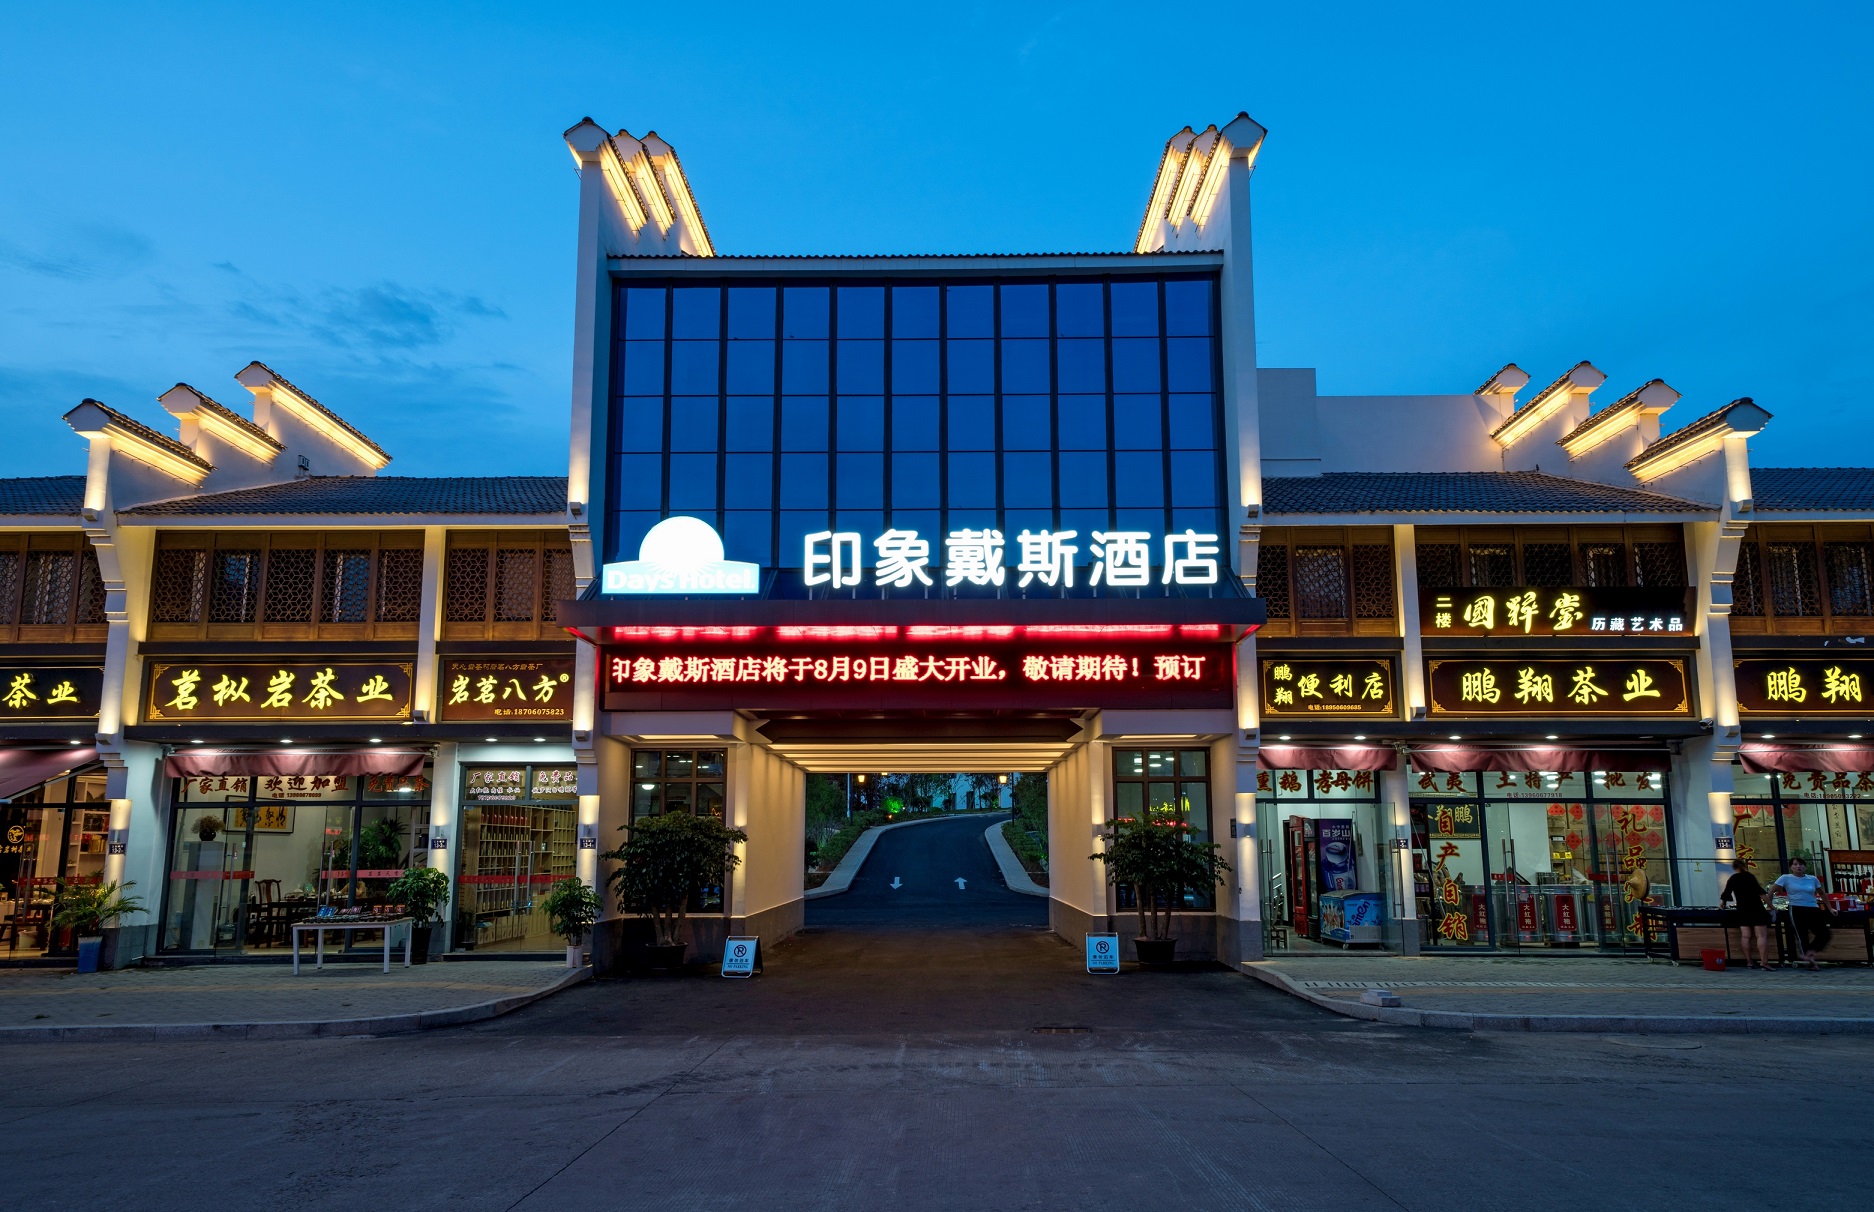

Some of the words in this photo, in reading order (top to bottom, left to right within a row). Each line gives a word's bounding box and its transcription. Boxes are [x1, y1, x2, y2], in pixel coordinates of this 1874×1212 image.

[804, 528, 1219, 589] 印象戴斯酒店
[607, 570, 677, 592] Days
[1436, 597, 1452, 628] 二楼
[1591, 617, 1683, 631] 历藏艺术品
[2, 672, 79, 708] 茶业
[449, 674, 558, 705] 岩茗八方
[1273, 663, 1293, 706] 鹏翔
[1297, 672, 1385, 700] 便利店
[1462, 667, 1661, 705] 鹏翔茶业
[1767, 666, 1862, 703] 鹏翔
[181, 776, 248, 794] 厂家直销
[264, 776, 349, 792] 欢迎加盟
[539, 770, 577, 784] 免费品
[1314, 769, 1374, 793] 孝母饼
[1418, 771, 1467, 792] 武夷
[1496, 771, 1573, 791] 土特产
[1782, 771, 1874, 792] 免费品茶
[1322, 829, 1350, 838] 百岁山
[1436, 811, 1469, 941] 自产自销
[1523, 904, 1532, 925] 大红袍
[1562, 904, 1571, 925] 大红袍
